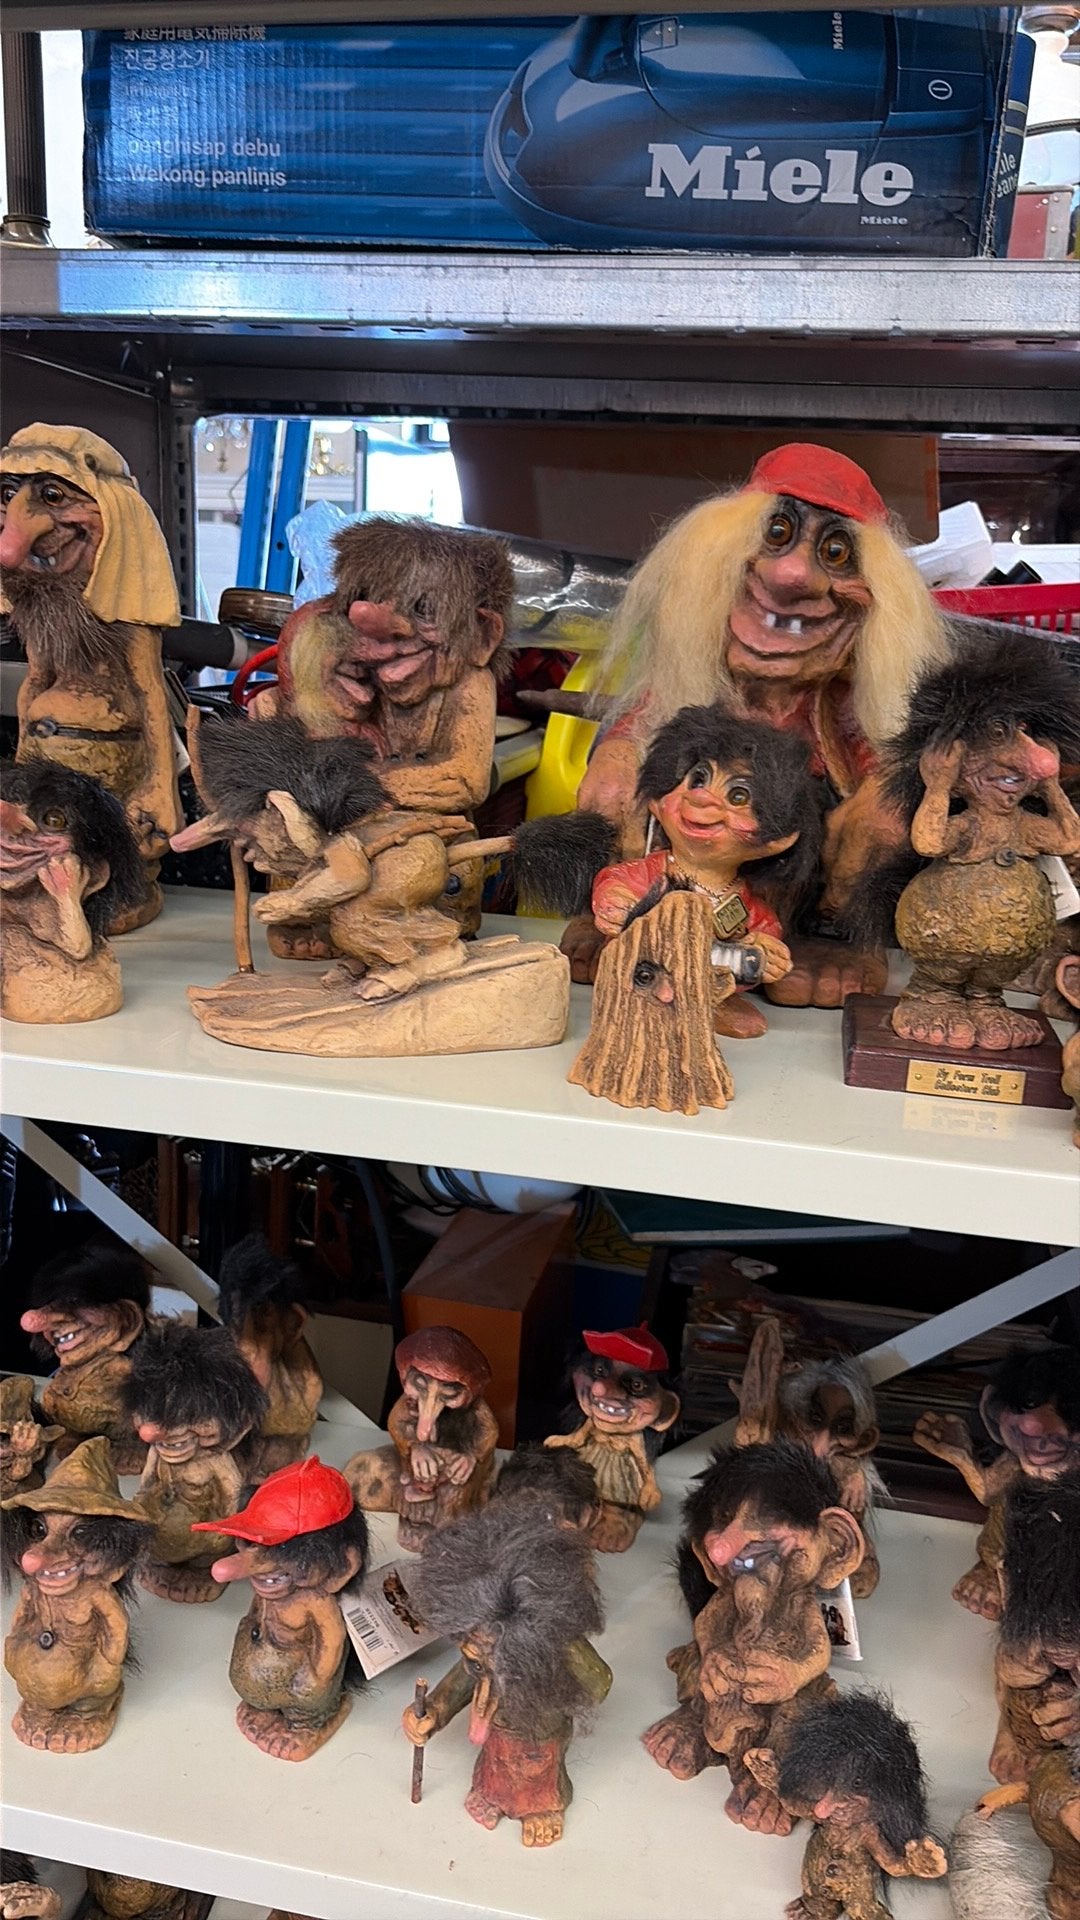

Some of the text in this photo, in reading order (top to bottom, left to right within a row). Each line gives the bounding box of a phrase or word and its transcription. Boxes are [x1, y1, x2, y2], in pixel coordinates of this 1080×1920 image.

[832, 11, 844, 50] Miele
[123, 48, 211, 71] 진공청소기
[128, 136, 281, 160] penghisap debu
[128, 163, 288, 188] Wekong panlinis
[645, 143, 914, 207] Miele
[860, 215, 909, 226] Miele
